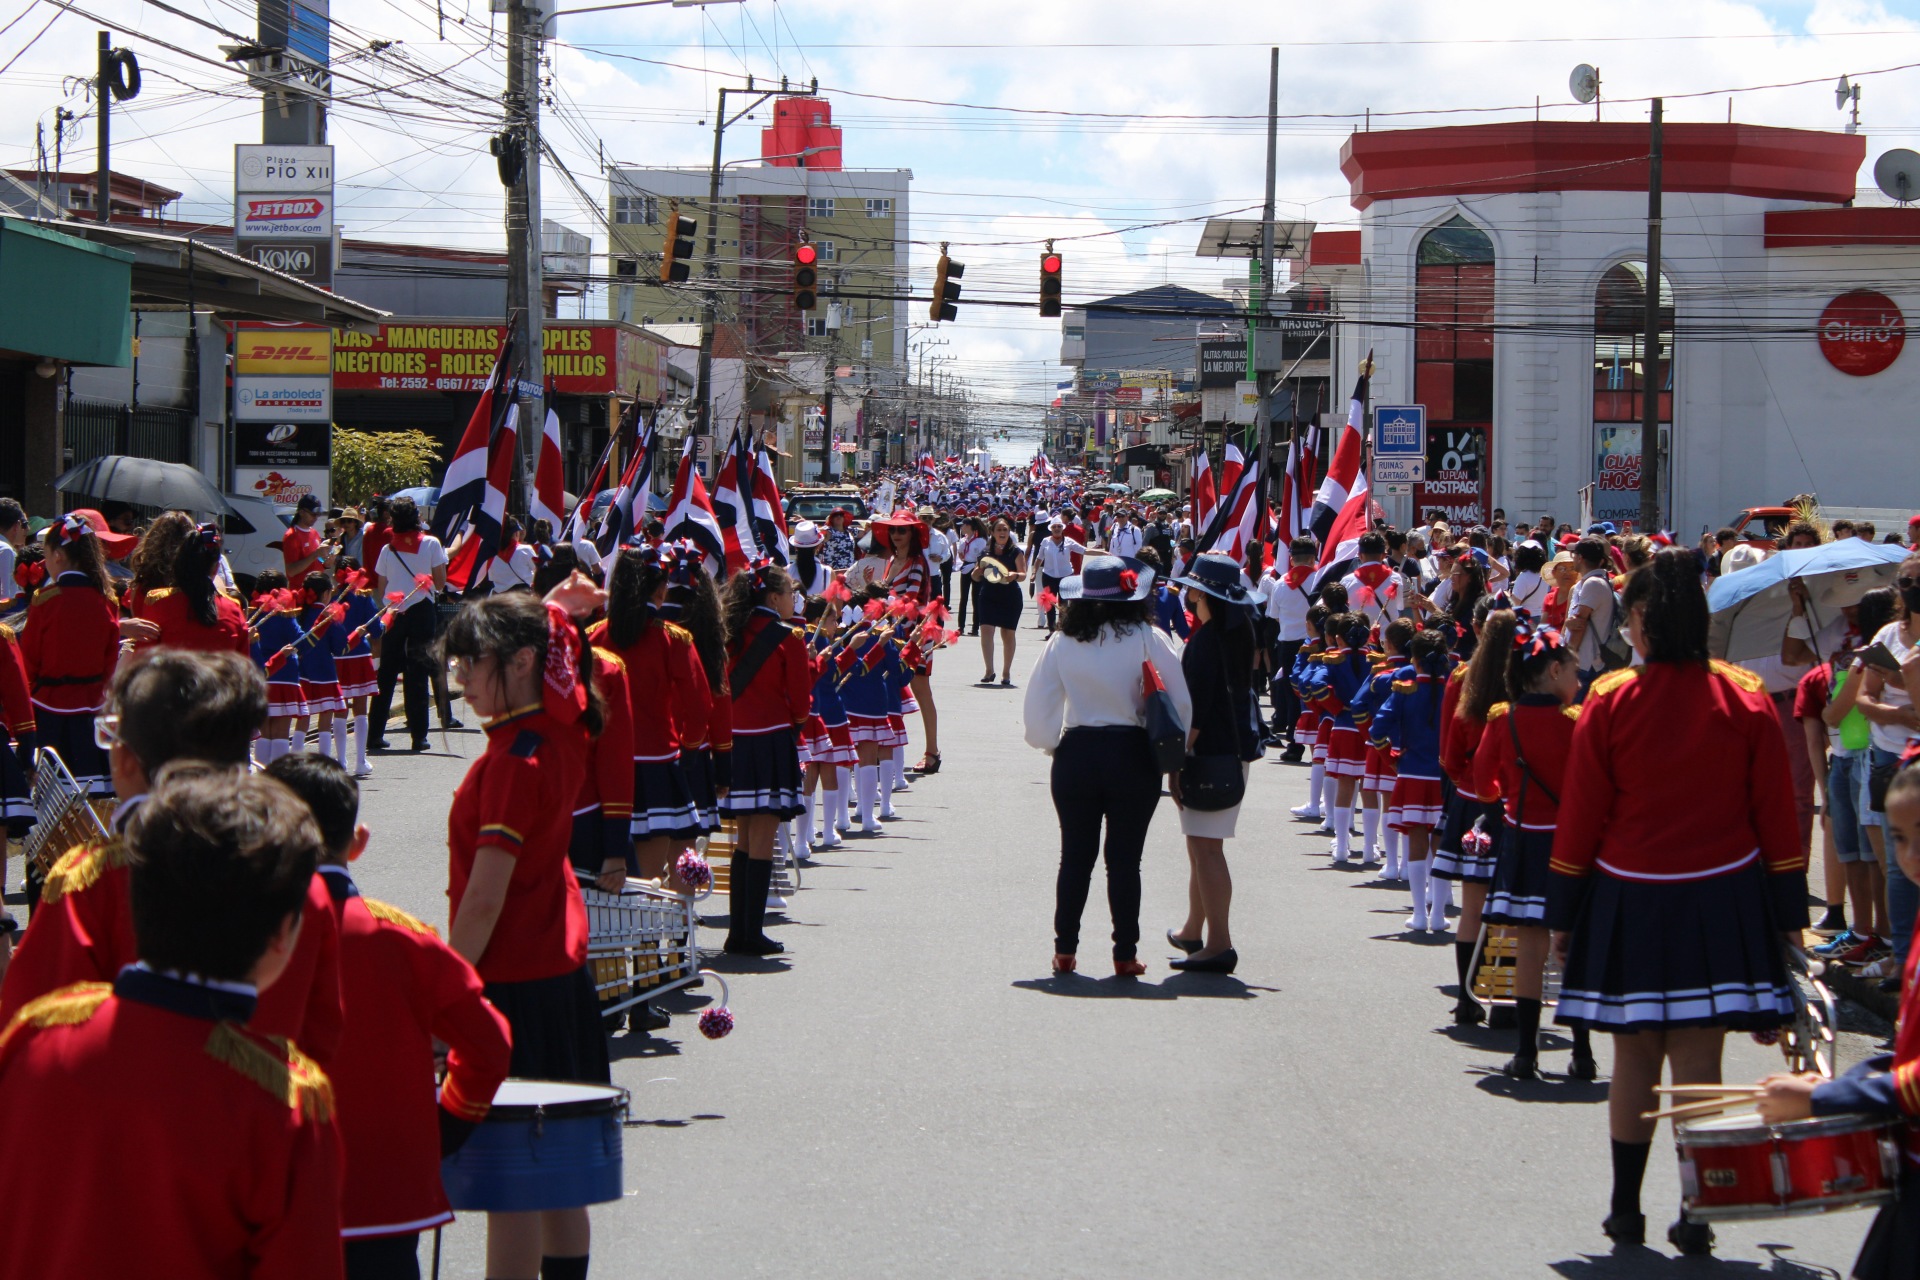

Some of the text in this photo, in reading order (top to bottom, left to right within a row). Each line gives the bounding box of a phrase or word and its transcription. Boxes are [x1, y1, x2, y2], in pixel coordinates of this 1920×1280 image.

[266, 156, 296, 164] Plaza
[266, 164, 329, 179] PÍO XII
[252, 202, 315, 216] JETBOX
[245, 223, 322, 234] www.jetbox.com
[258, 249, 311, 272] KOKA
[387, 327, 499, 350] MANGUERAS
[1823, 320, 1891, 343] Claro
[252, 346, 313, 361] DHL
[441, 353, 496, 375] ROLES
[543, 354, 607, 377] NILLOS
[1203, 361, 1212, 372] LA
[1212, 361, 1234, 372] MEJOR
[380, 376, 400, 389] Tel:
[401, 377, 428, 390] 2552
[436, 377, 463, 391] 0567
[255, 388, 322, 399] La arboleda
[1378, 461, 1404, 470] RUINAS
[1378, 471, 1409, 480] CARTAGO
[1438, 470, 1468, 480] TU PLAN
